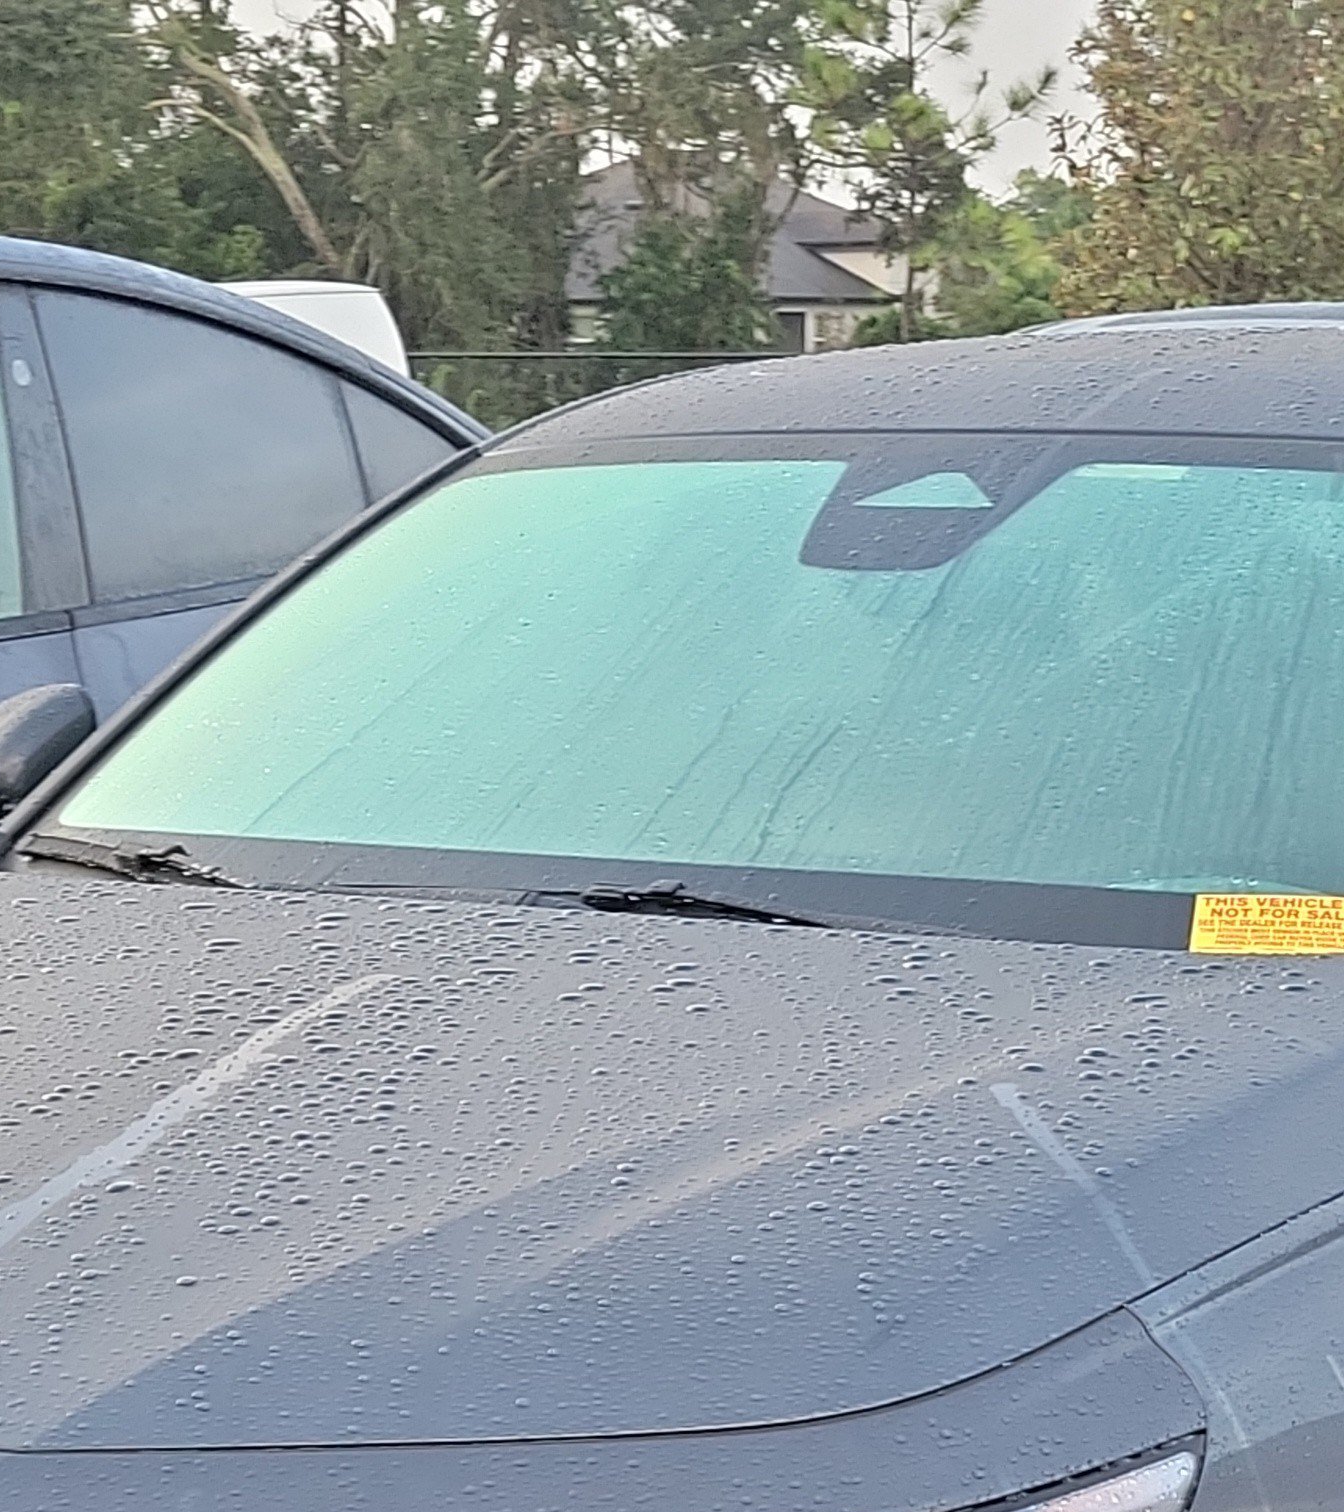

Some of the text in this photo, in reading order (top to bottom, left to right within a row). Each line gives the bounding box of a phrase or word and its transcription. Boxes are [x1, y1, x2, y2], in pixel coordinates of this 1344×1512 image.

[1202, 897, 1248, 907] THIS
[1256, 897, 1343, 910] VEHICLE
[1210, 907, 1253, 918] NOT
[1260, 908, 1300, 919] FOR
